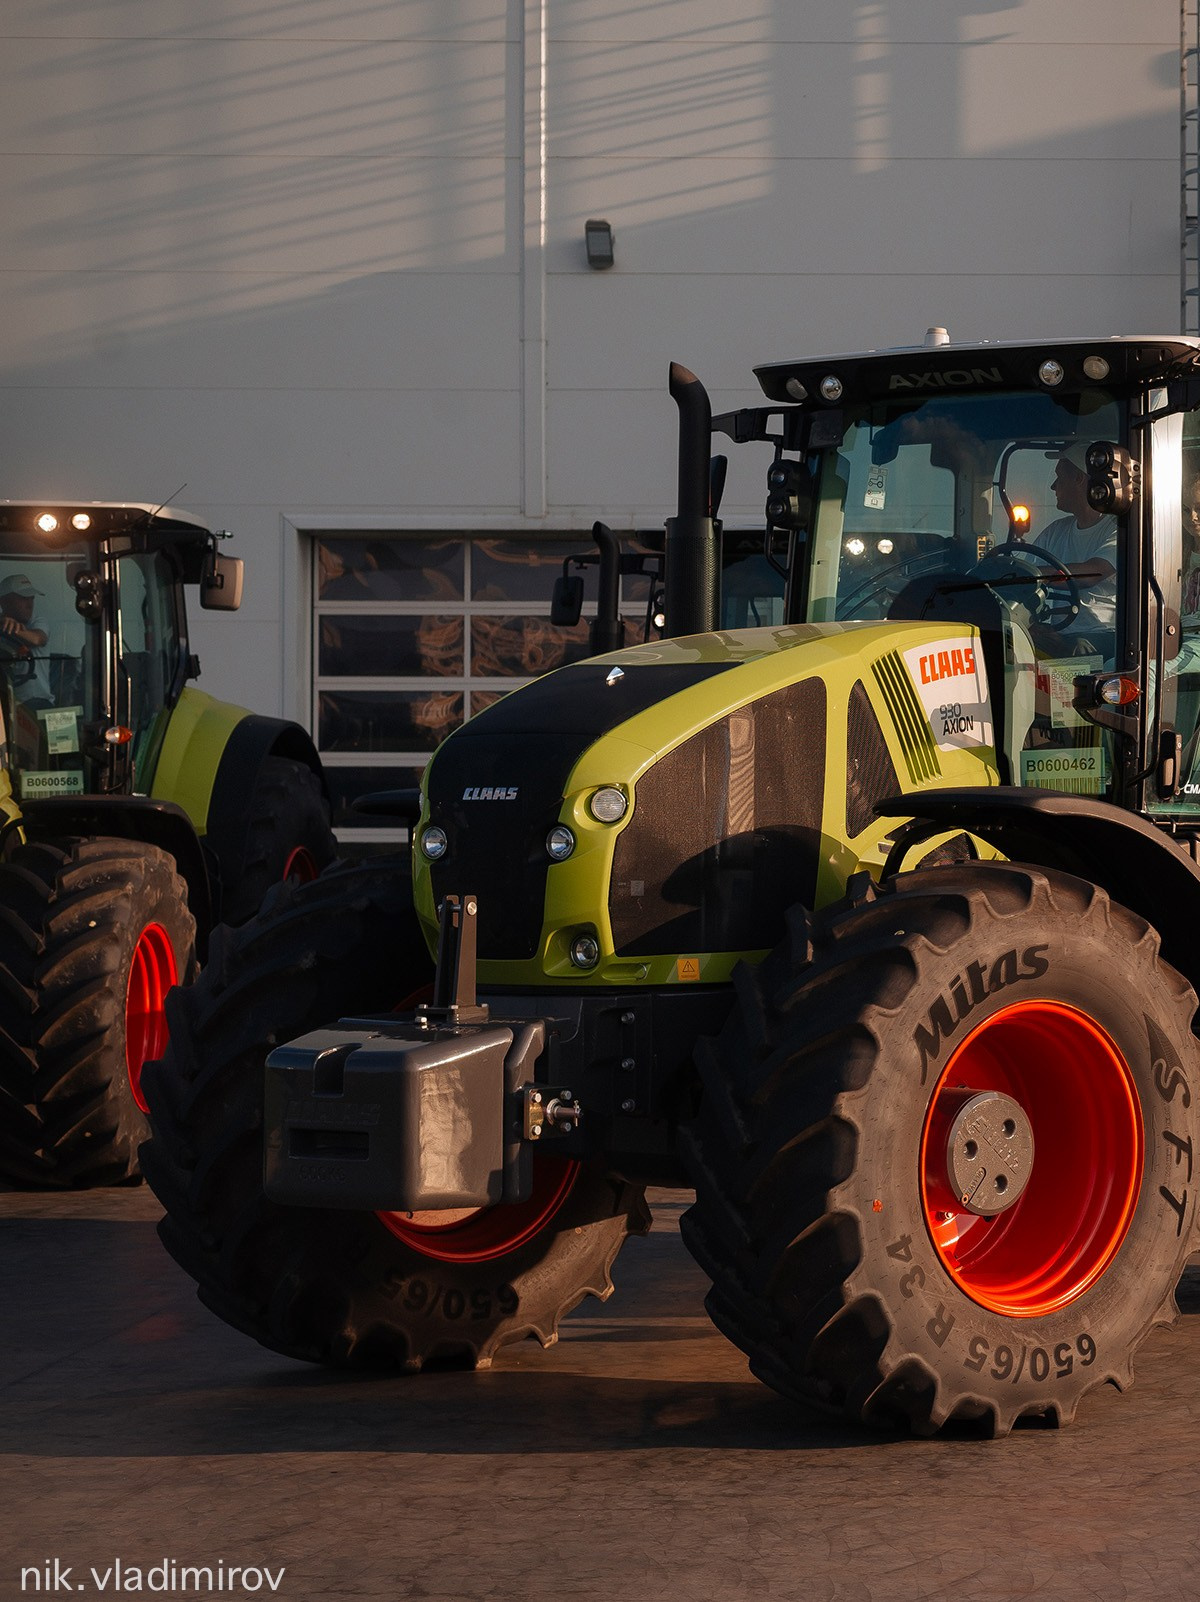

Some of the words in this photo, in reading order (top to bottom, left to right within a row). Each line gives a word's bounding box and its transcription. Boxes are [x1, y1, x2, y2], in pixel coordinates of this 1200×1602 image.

[888, 367, 1004, 390] AXION
[919, 648, 976, 685] CLAAS
[940, 702, 962, 720] 930
[942, 715, 974, 736] AXION
[1026, 757, 1096, 773] B0600462
[26, 776, 79, 787] B0600568
[462, 787, 520, 801] CLAAS
[912, 944, 1049, 1086] Mitas
[885, 1233, 926, 1299] 34
[925, 1302, 956, 1349] R
[962, 1332, 1097, 1385] 650/65
